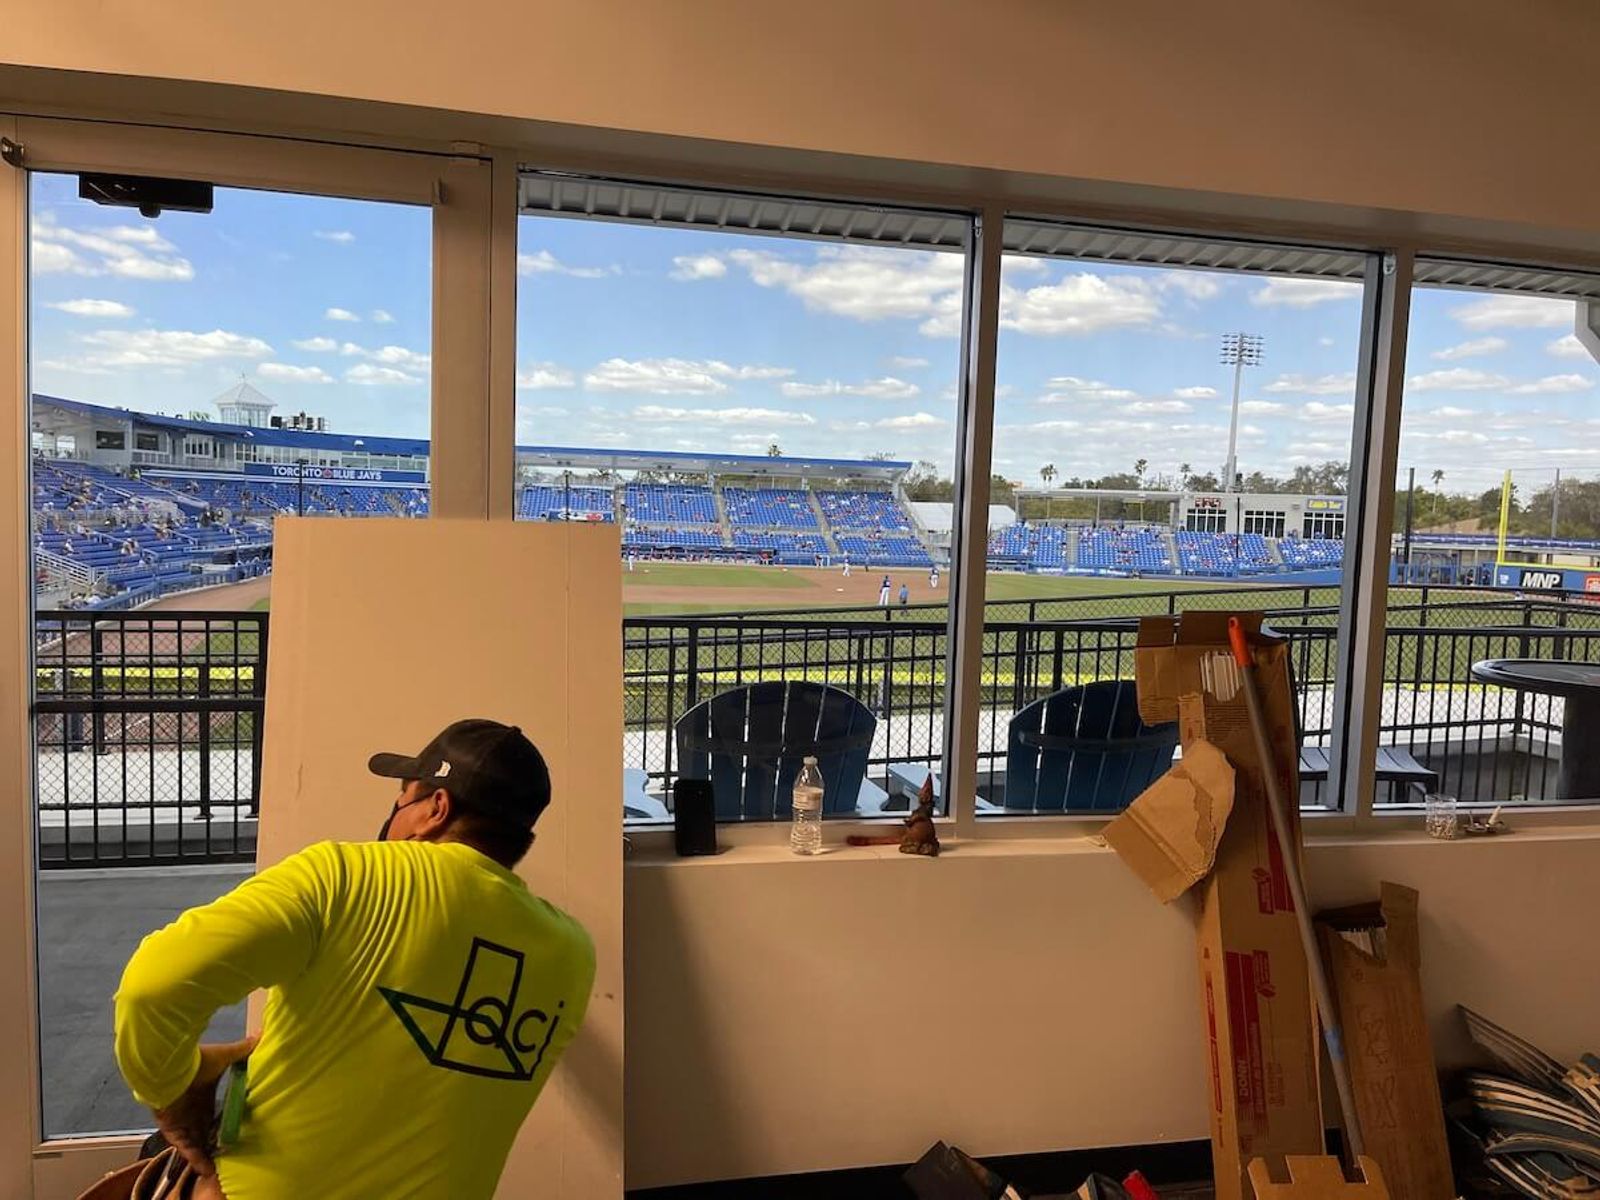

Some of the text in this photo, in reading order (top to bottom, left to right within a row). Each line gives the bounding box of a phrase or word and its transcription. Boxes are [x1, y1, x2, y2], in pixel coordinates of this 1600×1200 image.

[333, 469, 356, 479] BLUE
[357, 470, 382, 480] JAYS
[1522, 572, 1560, 589] MNP
